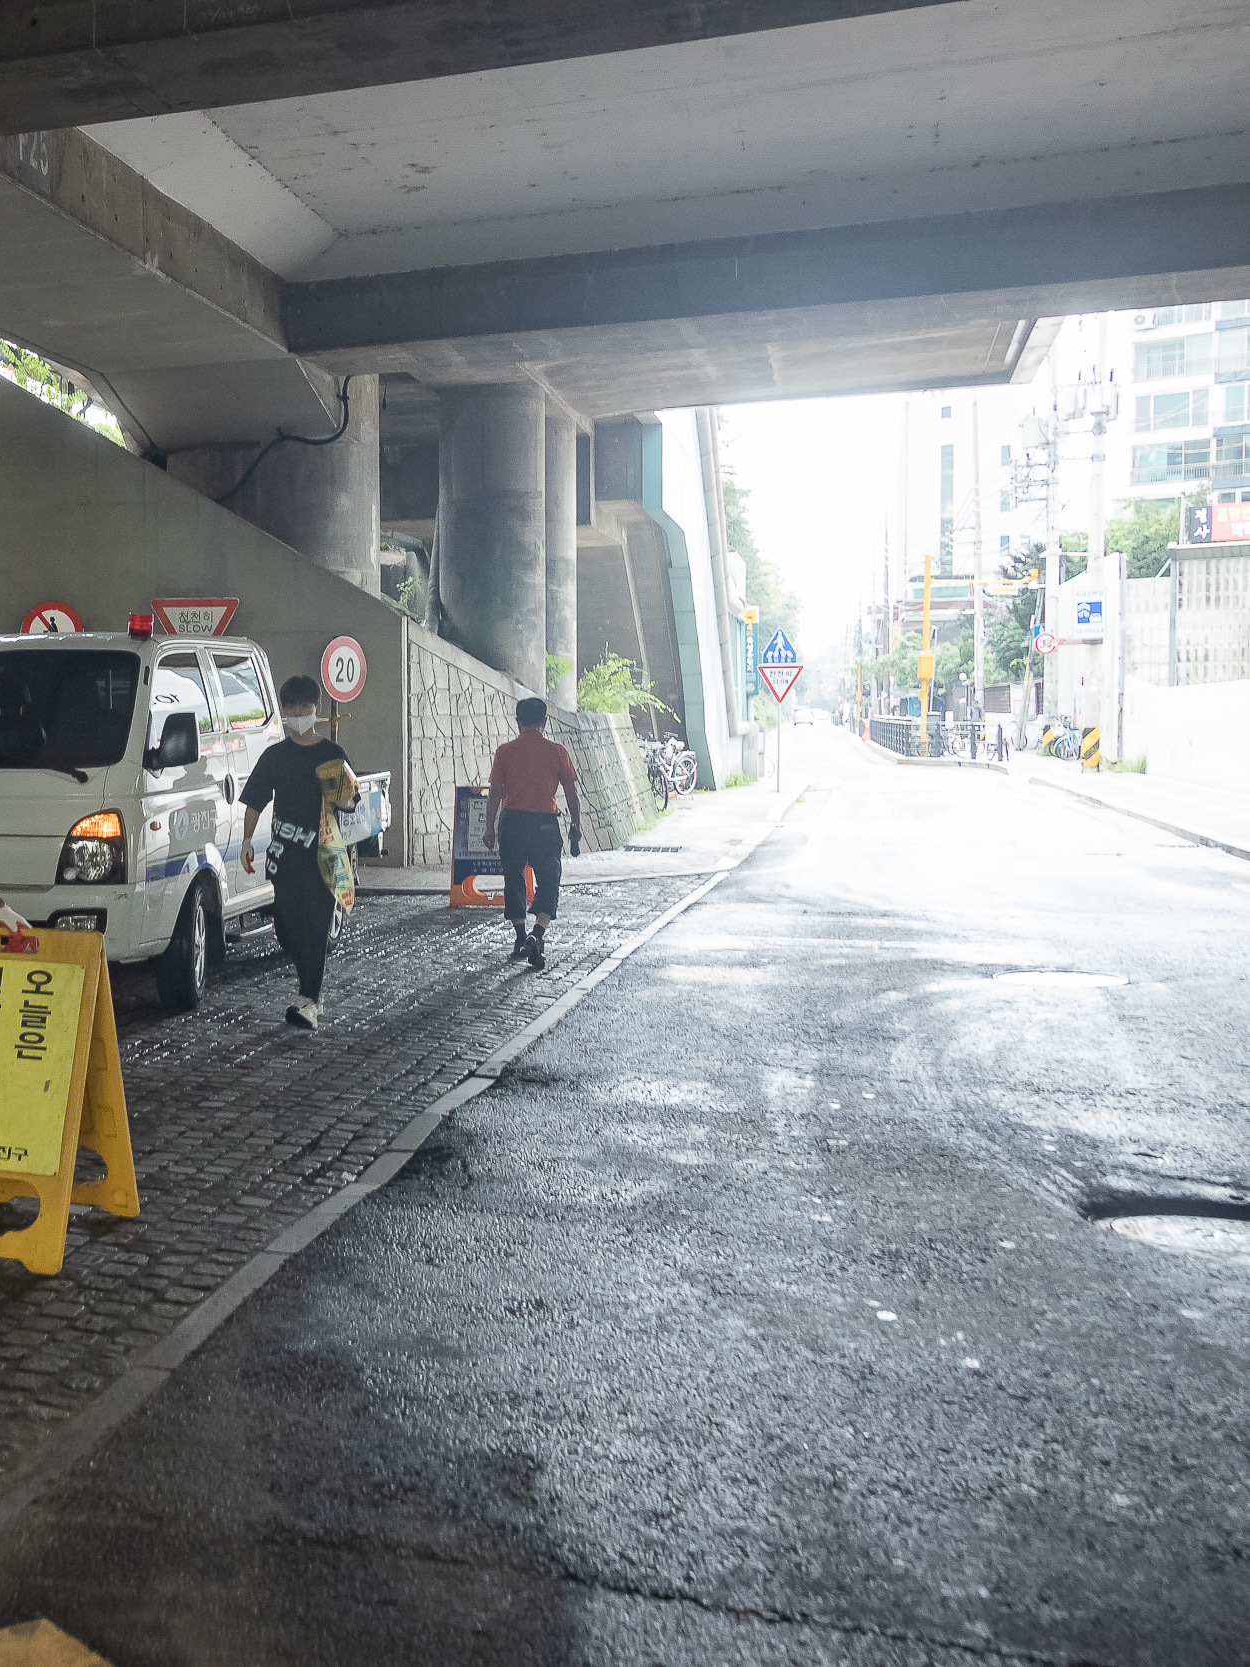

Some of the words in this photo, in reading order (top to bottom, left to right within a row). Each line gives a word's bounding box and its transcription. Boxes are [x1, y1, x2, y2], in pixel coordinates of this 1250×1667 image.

[178, 610, 214, 624] 천천히
[178, 624, 213, 633] SLOW
[335, 656, 356, 683] 20
[16, 969, 55, 1062] 오늘은
